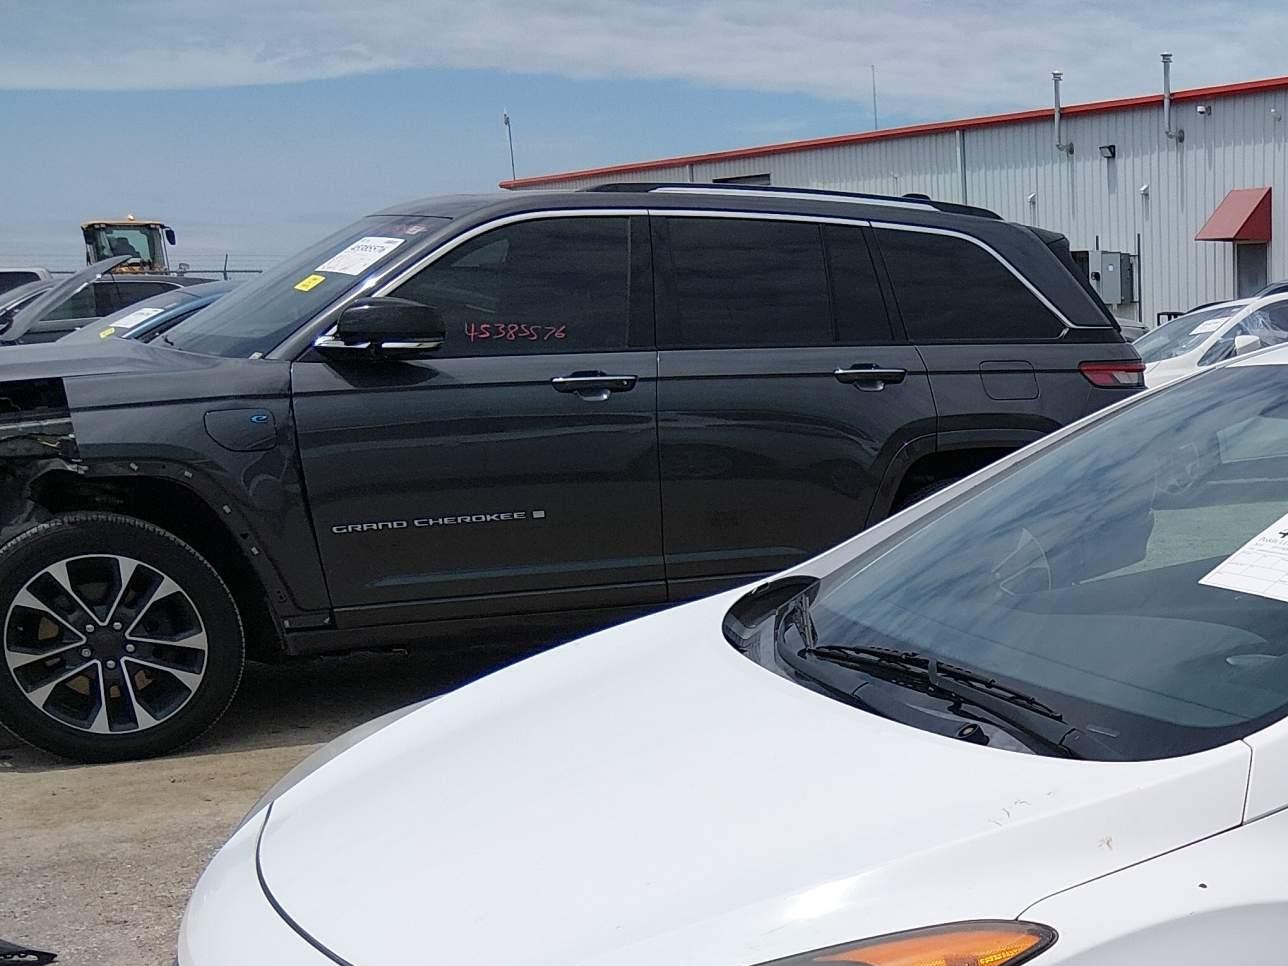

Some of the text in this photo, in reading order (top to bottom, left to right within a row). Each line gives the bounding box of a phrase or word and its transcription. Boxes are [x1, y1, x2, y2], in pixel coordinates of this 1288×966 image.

[464, 320, 567, 342] 45385576
[332, 511, 527, 534] GRAND CHEROKEE
